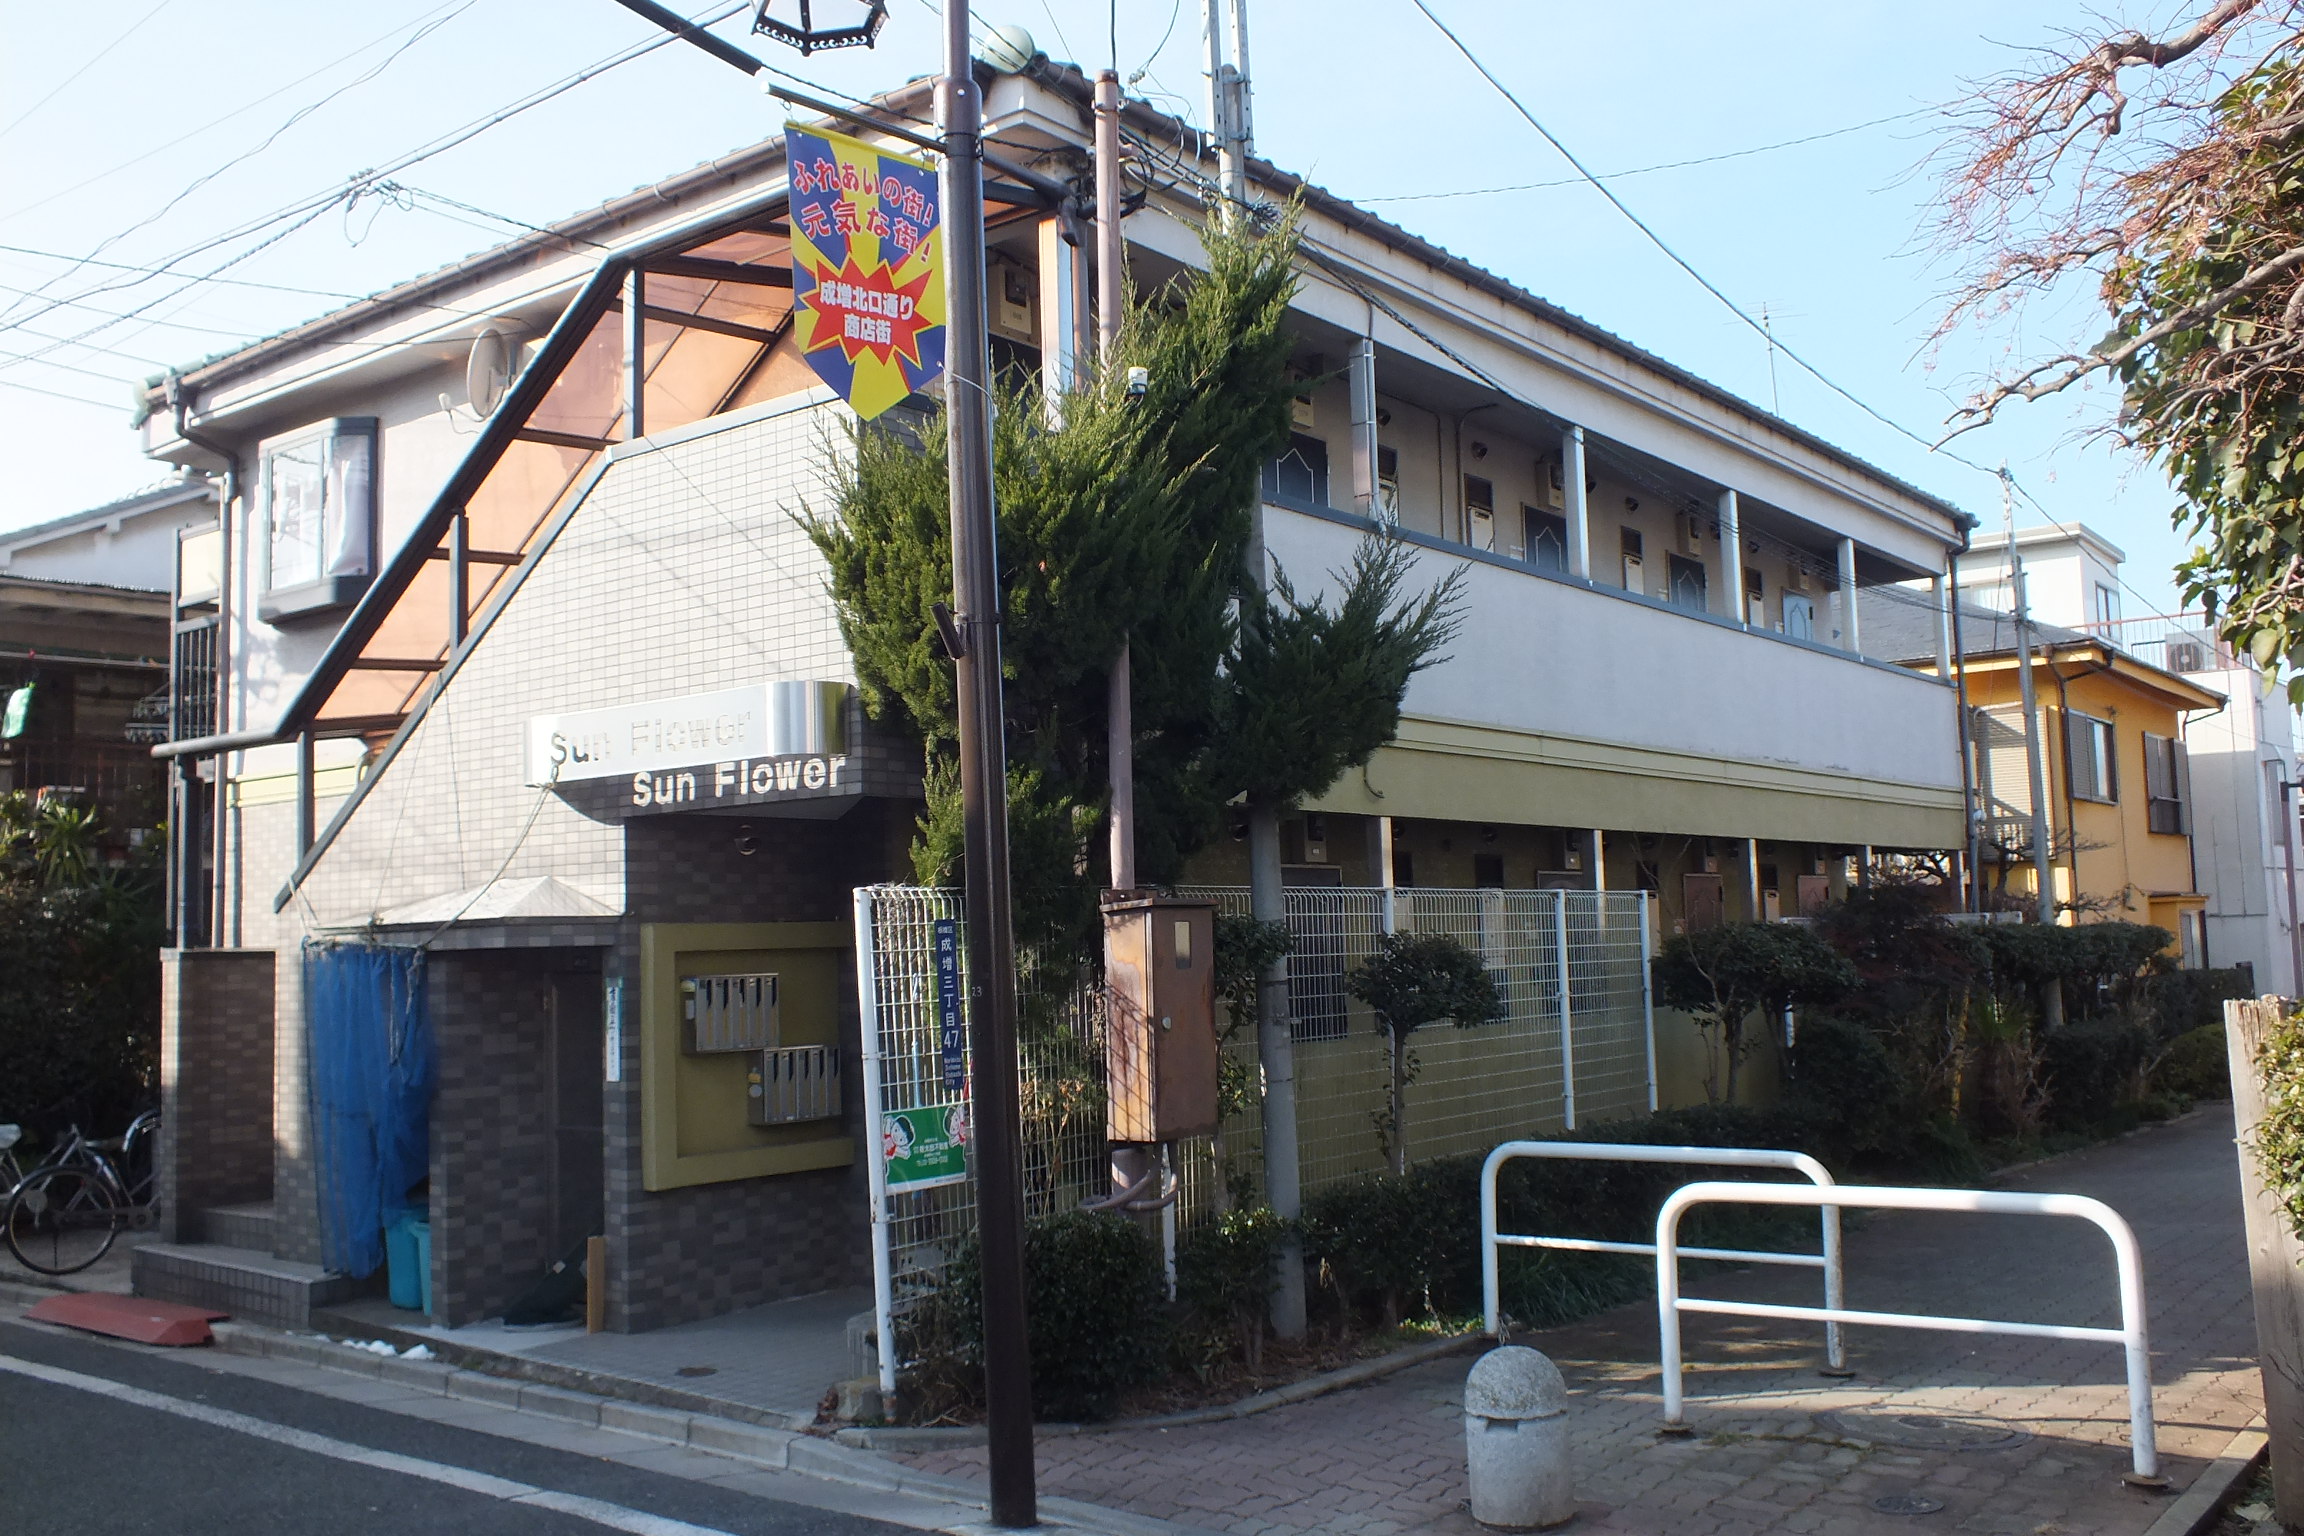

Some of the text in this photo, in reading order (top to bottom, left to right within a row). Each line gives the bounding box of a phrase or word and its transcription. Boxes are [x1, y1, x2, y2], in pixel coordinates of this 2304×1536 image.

[794, 158, 933, 226] ふれあいの街!
[800, 199, 932, 262] 元気な街!
[820, 280, 914, 320] 成増北口通り
[844, 314, 892, 345] 商店街
[551, 712, 751, 763] Sun Flower
[632, 755, 847, 807] Sun Flower
[941, 937, 955, 1027] 成増三丁目
[943, 1030, 960, 1049] 47
